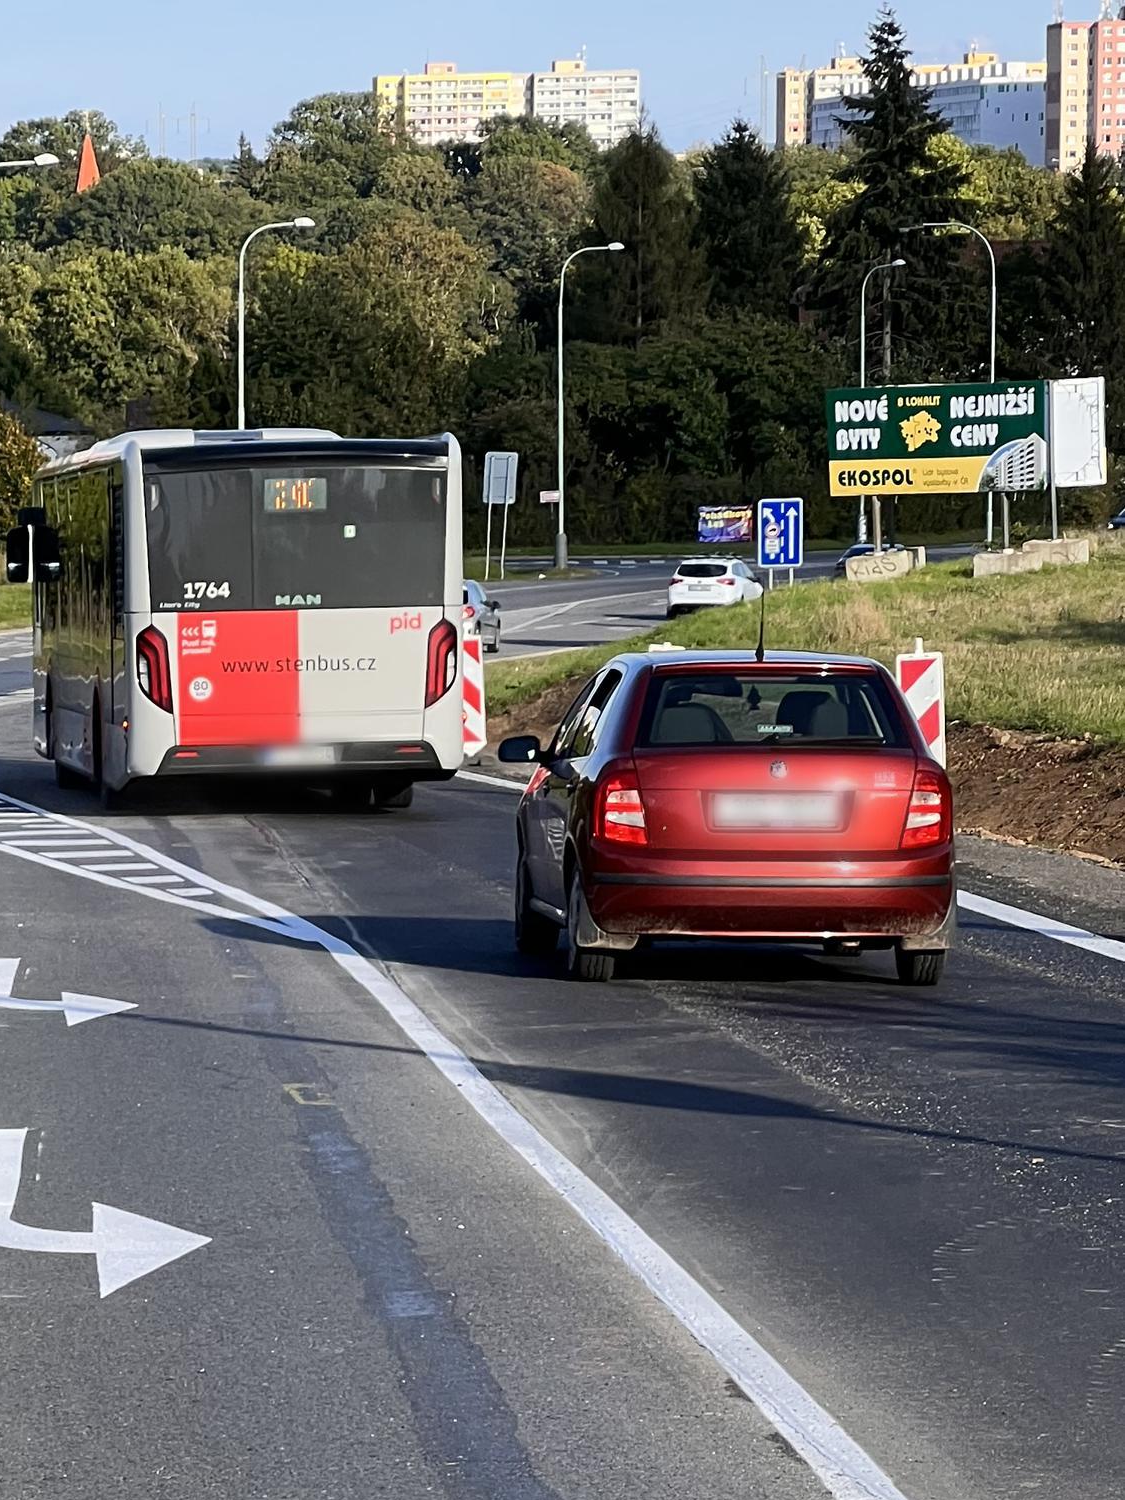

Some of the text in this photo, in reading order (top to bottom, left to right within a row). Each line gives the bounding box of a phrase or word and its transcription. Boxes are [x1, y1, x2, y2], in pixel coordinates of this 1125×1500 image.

[834, 386, 1036, 423] NOVÉ NEJNIŽŠÍ
[905, 395, 941, 407] LOKALIT
[835, 423, 999, 451] BYTY CENY
[837, 468, 914, 487] EKOSPOL
[183, 581, 231, 599] 1764
[275, 594, 322, 606] MAN
[389, 611, 422, 634] pid
[221, 654, 377, 674] www.stenbus.cz
[193, 680, 209, 691] 80
